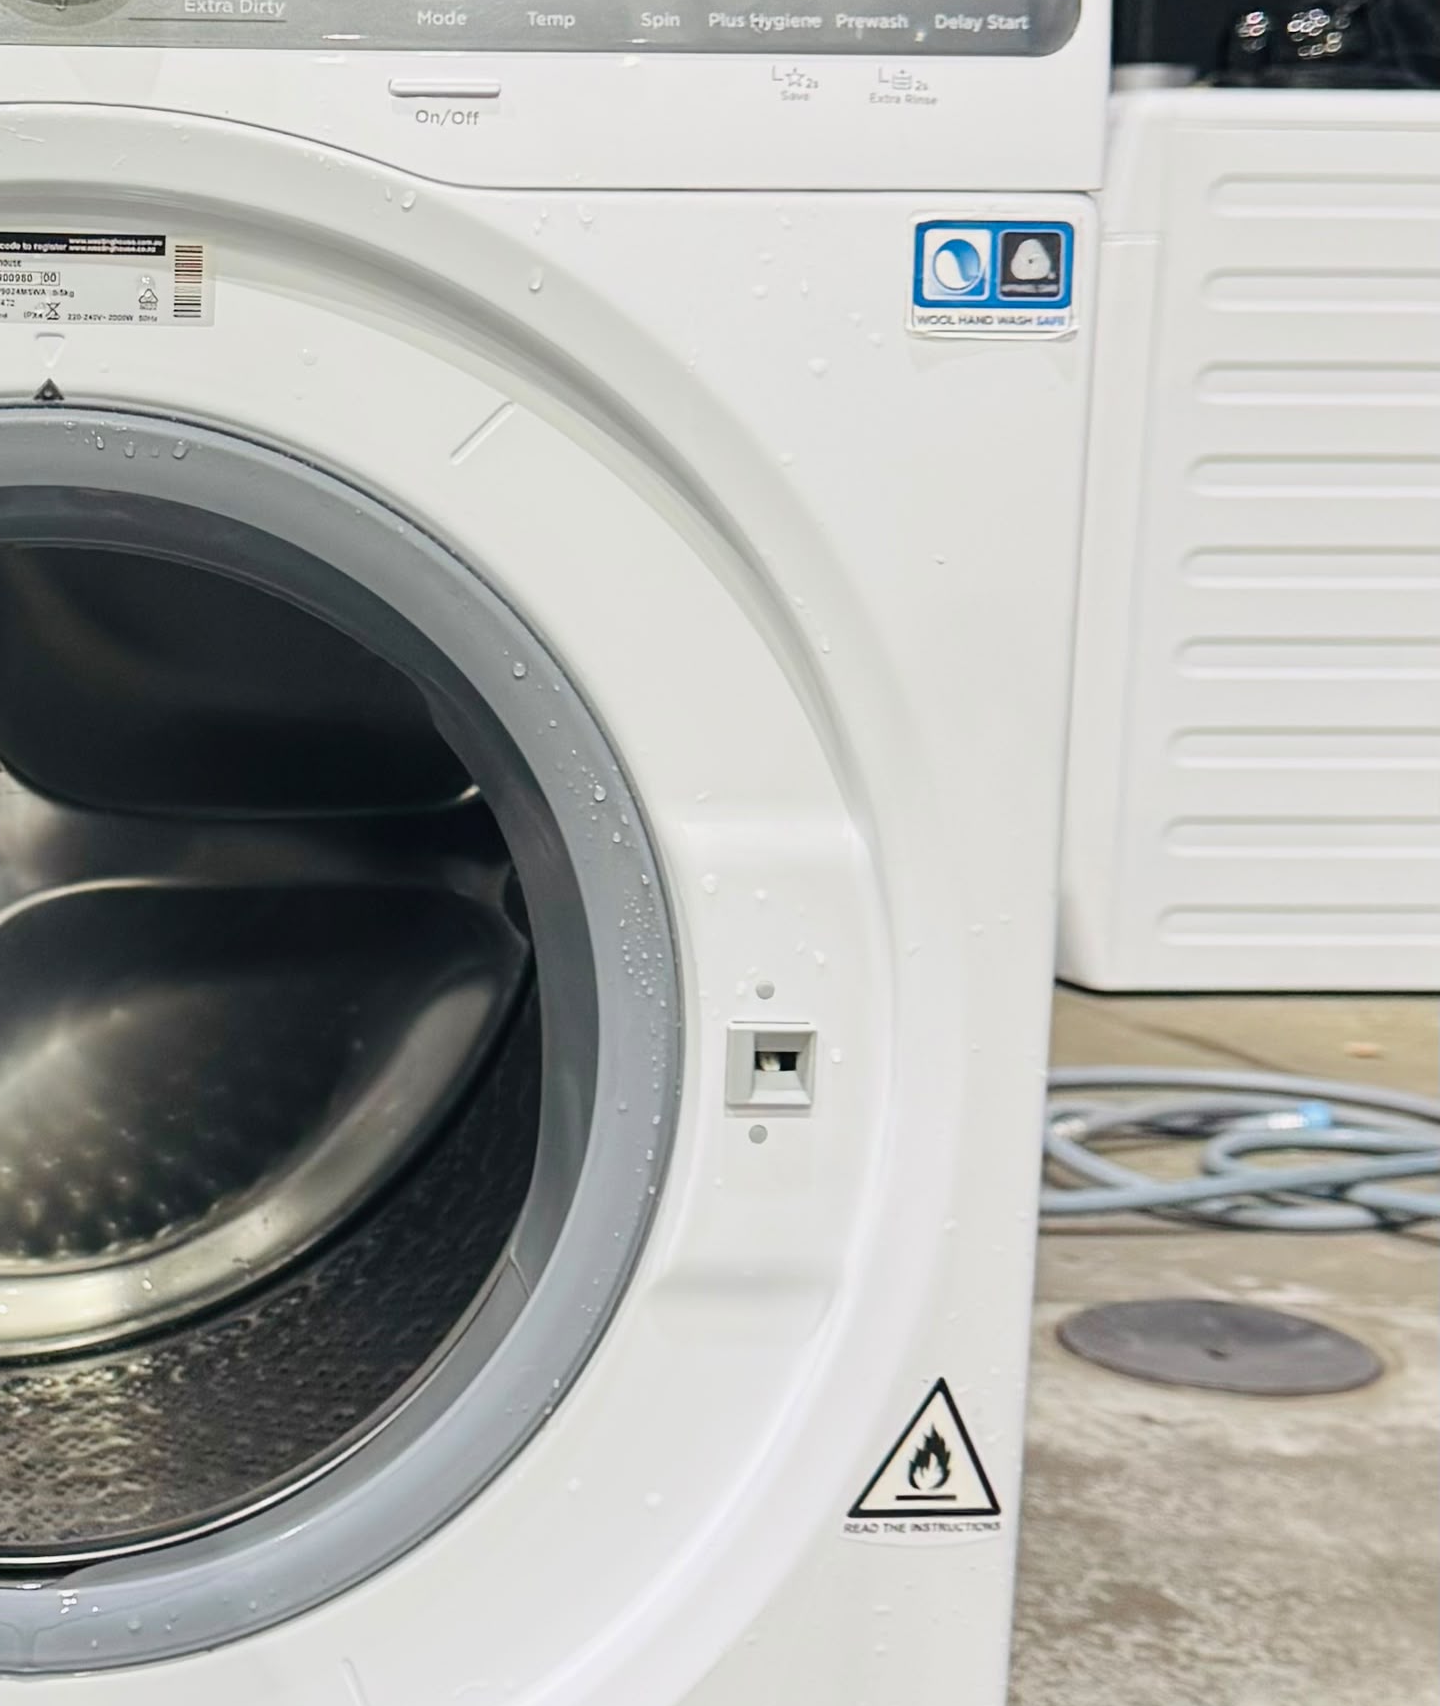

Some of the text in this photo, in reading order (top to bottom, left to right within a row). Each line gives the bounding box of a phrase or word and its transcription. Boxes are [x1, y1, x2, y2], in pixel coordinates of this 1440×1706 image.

[417, 10, 468, 26] Mode
[527, 11, 576, 29] Temp
[640, 12, 681, 29] Spin
[708, 12, 822, 33] Plus Hygiene
[835, 13, 909, 30] Prewash
[935, 14, 1029, 33] Delay Start
[780, 90, 810, 102] Save
[869, 92, 901, 105] Extra
[415, 109, 480, 126] On/Off
[0, 241, 21, 251] code
[22, 242, 32, 251] to
[33, 243, 68, 253] register
[915, 314, 956, 325] WOOL
[959, 315, 993, 325] HAND
[997, 315, 1033, 326] WASH
[843, 1521, 1001, 1534] READ THE INSTRUCTIONS
